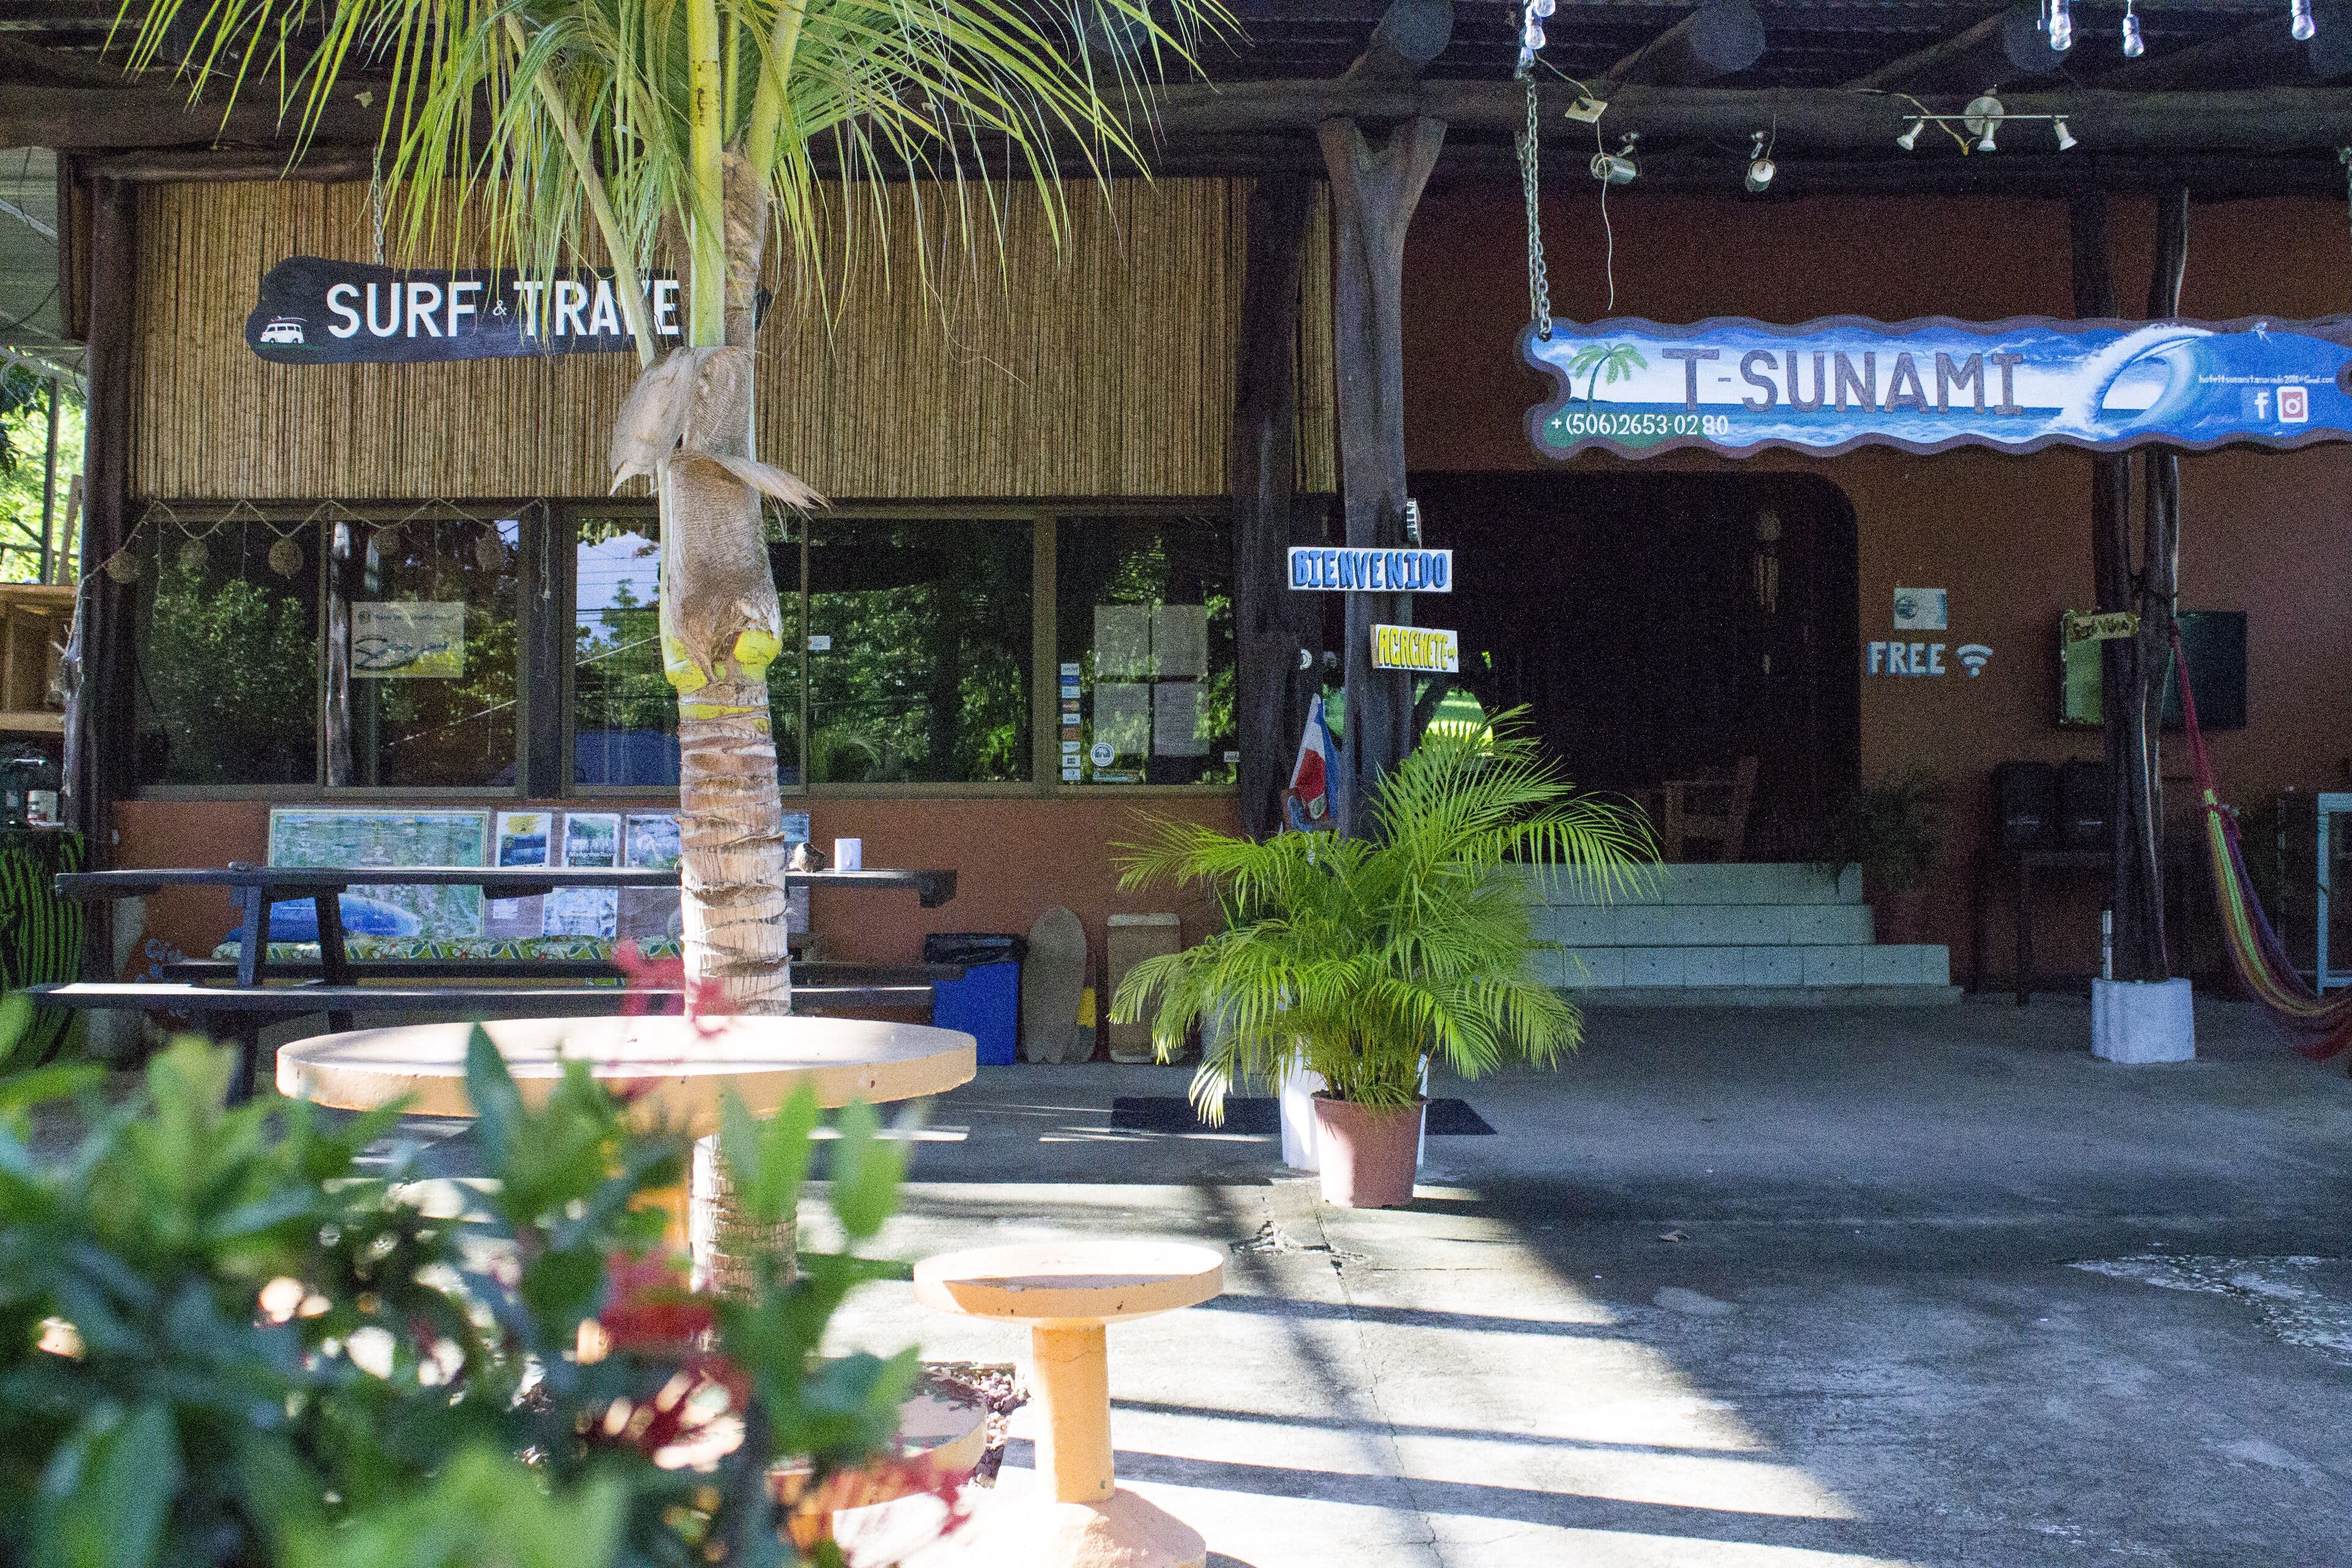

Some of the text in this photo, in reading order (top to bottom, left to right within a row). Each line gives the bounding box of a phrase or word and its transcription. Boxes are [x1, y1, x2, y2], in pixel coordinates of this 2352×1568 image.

[326, 281, 482, 338] SURF
[492, 299, 508, 317] &
[1662, 347, 2024, 416] T-SUNAMI
[1292, 550, 1447, 589] BIENVENIDO
[1378, 627, 1449, 671] ACACHETE
[1866, 641, 1945, 677] FREE
